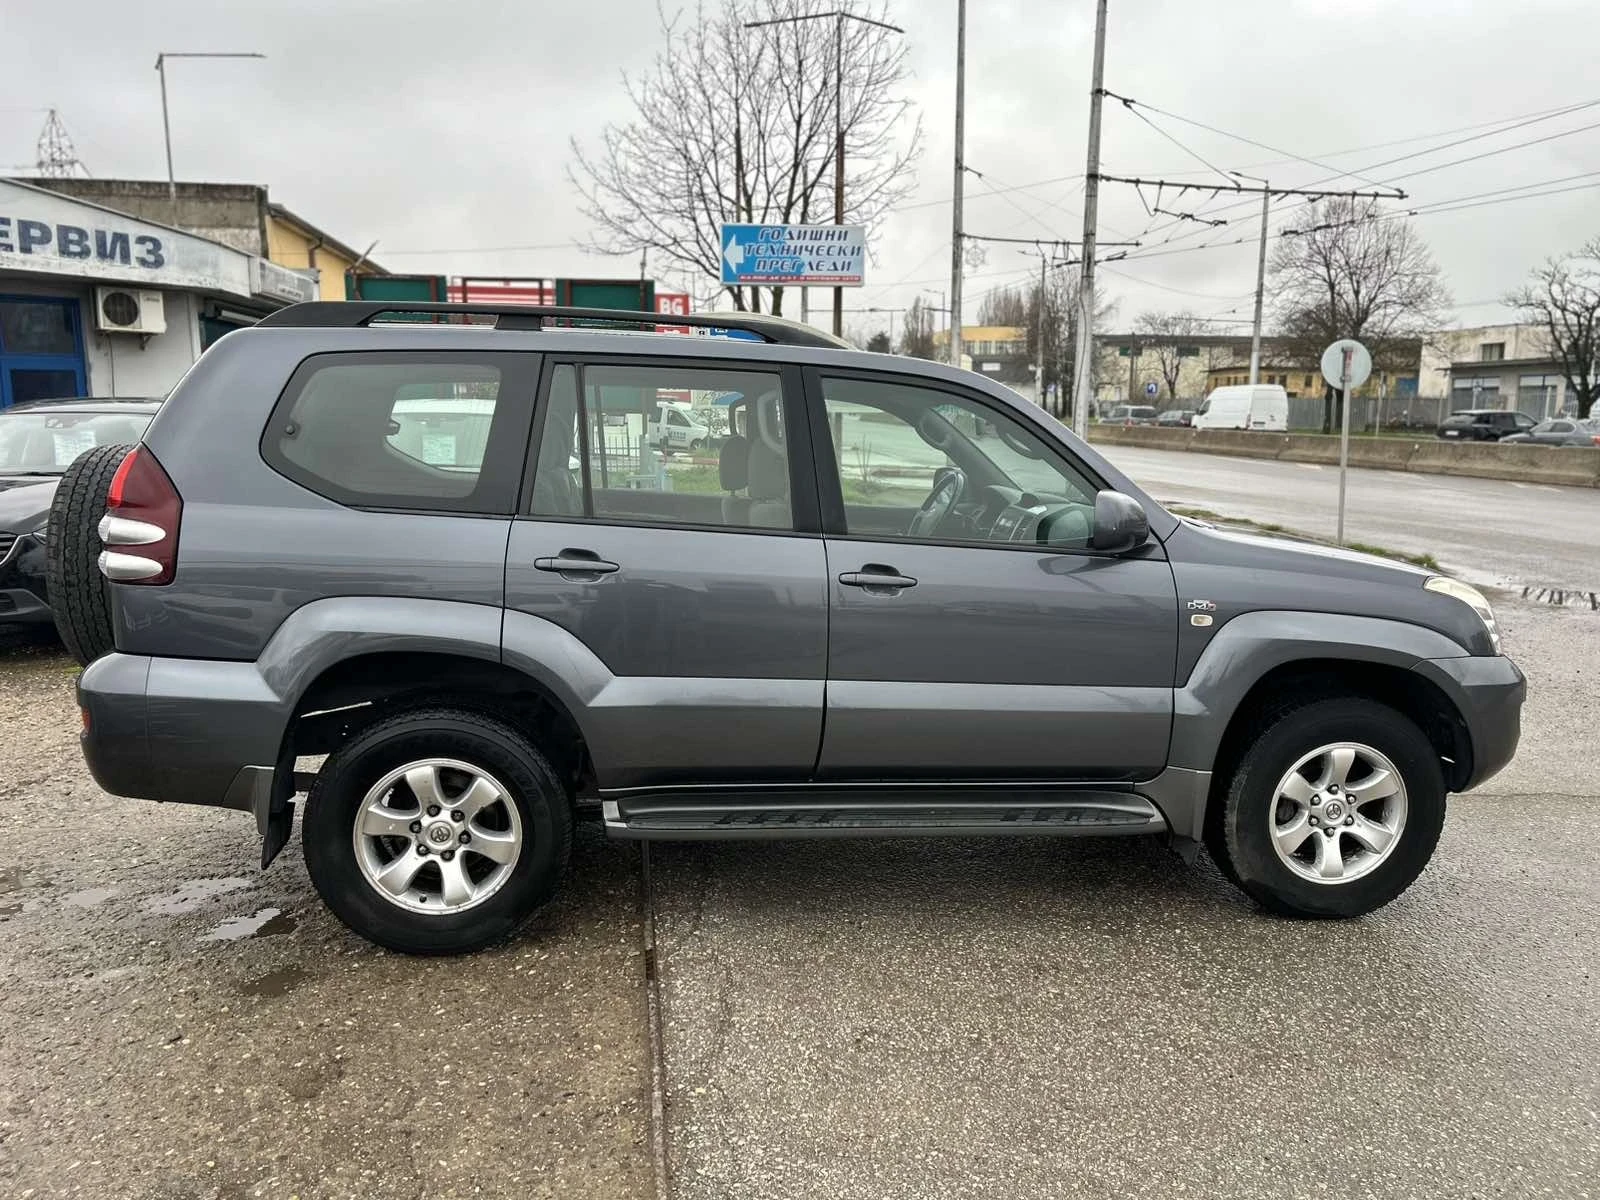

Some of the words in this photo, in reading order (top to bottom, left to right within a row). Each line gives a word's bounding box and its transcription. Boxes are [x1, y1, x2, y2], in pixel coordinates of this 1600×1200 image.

[760, 228, 848, 241] ГОДИШНИ
[745, 244, 862, 257] ТЕХНИЧЕСКИ
[755, 259, 852, 272] ПРЕГЛЕДИ
[661, 297, 683, 315] BG
